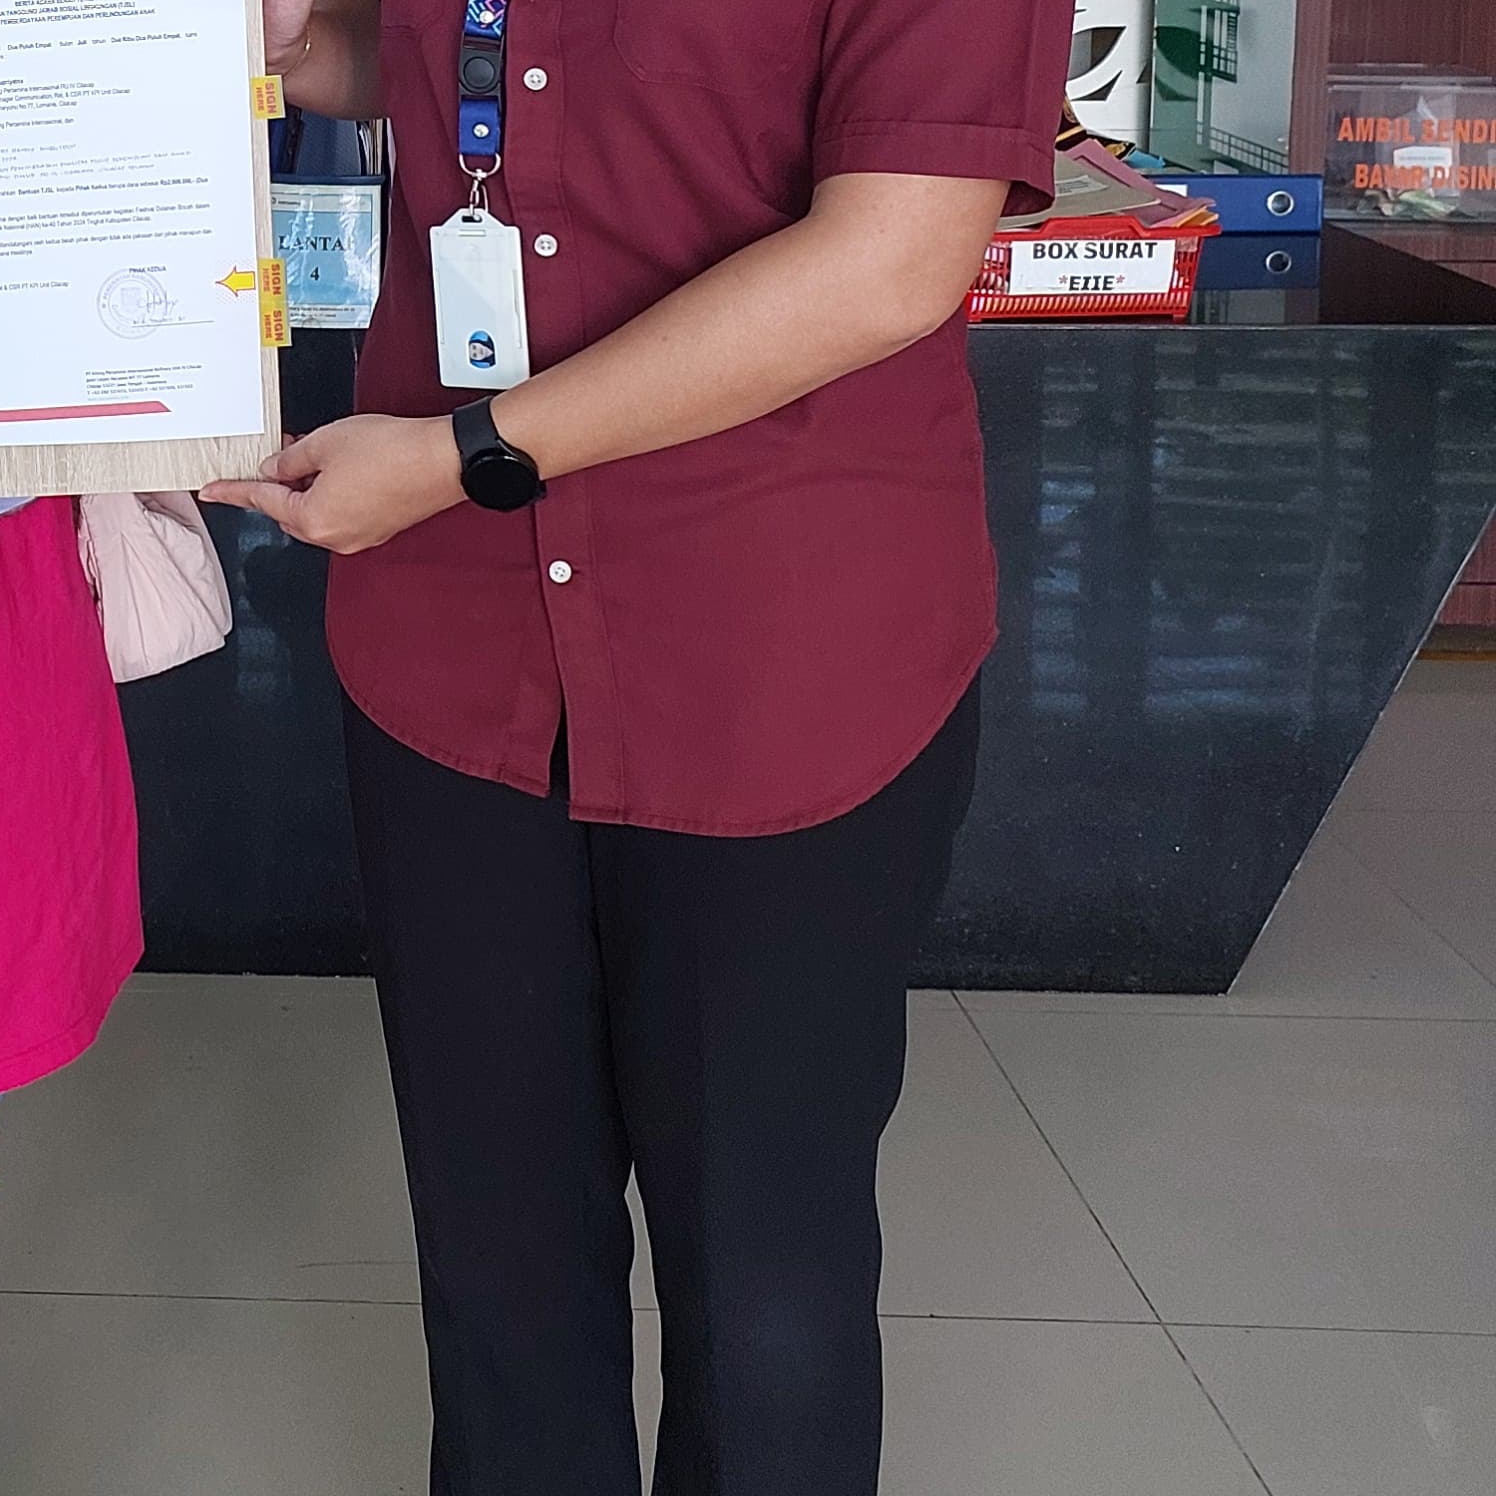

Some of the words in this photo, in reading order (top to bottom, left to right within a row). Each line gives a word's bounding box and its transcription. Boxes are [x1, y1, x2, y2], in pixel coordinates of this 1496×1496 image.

[256, 87, 264, 111] HERE
[265, 82, 277, 114] SIGN
[1337, 116, 1415, 143] AMBIL
[1033, 242, 1078, 259] BOX
[1083, 242, 1157, 259] SURAT
[271, 263, 281, 295] SIGN
[310, 266, 320, 281] 4
[273, 310, 284, 341] SIGN
